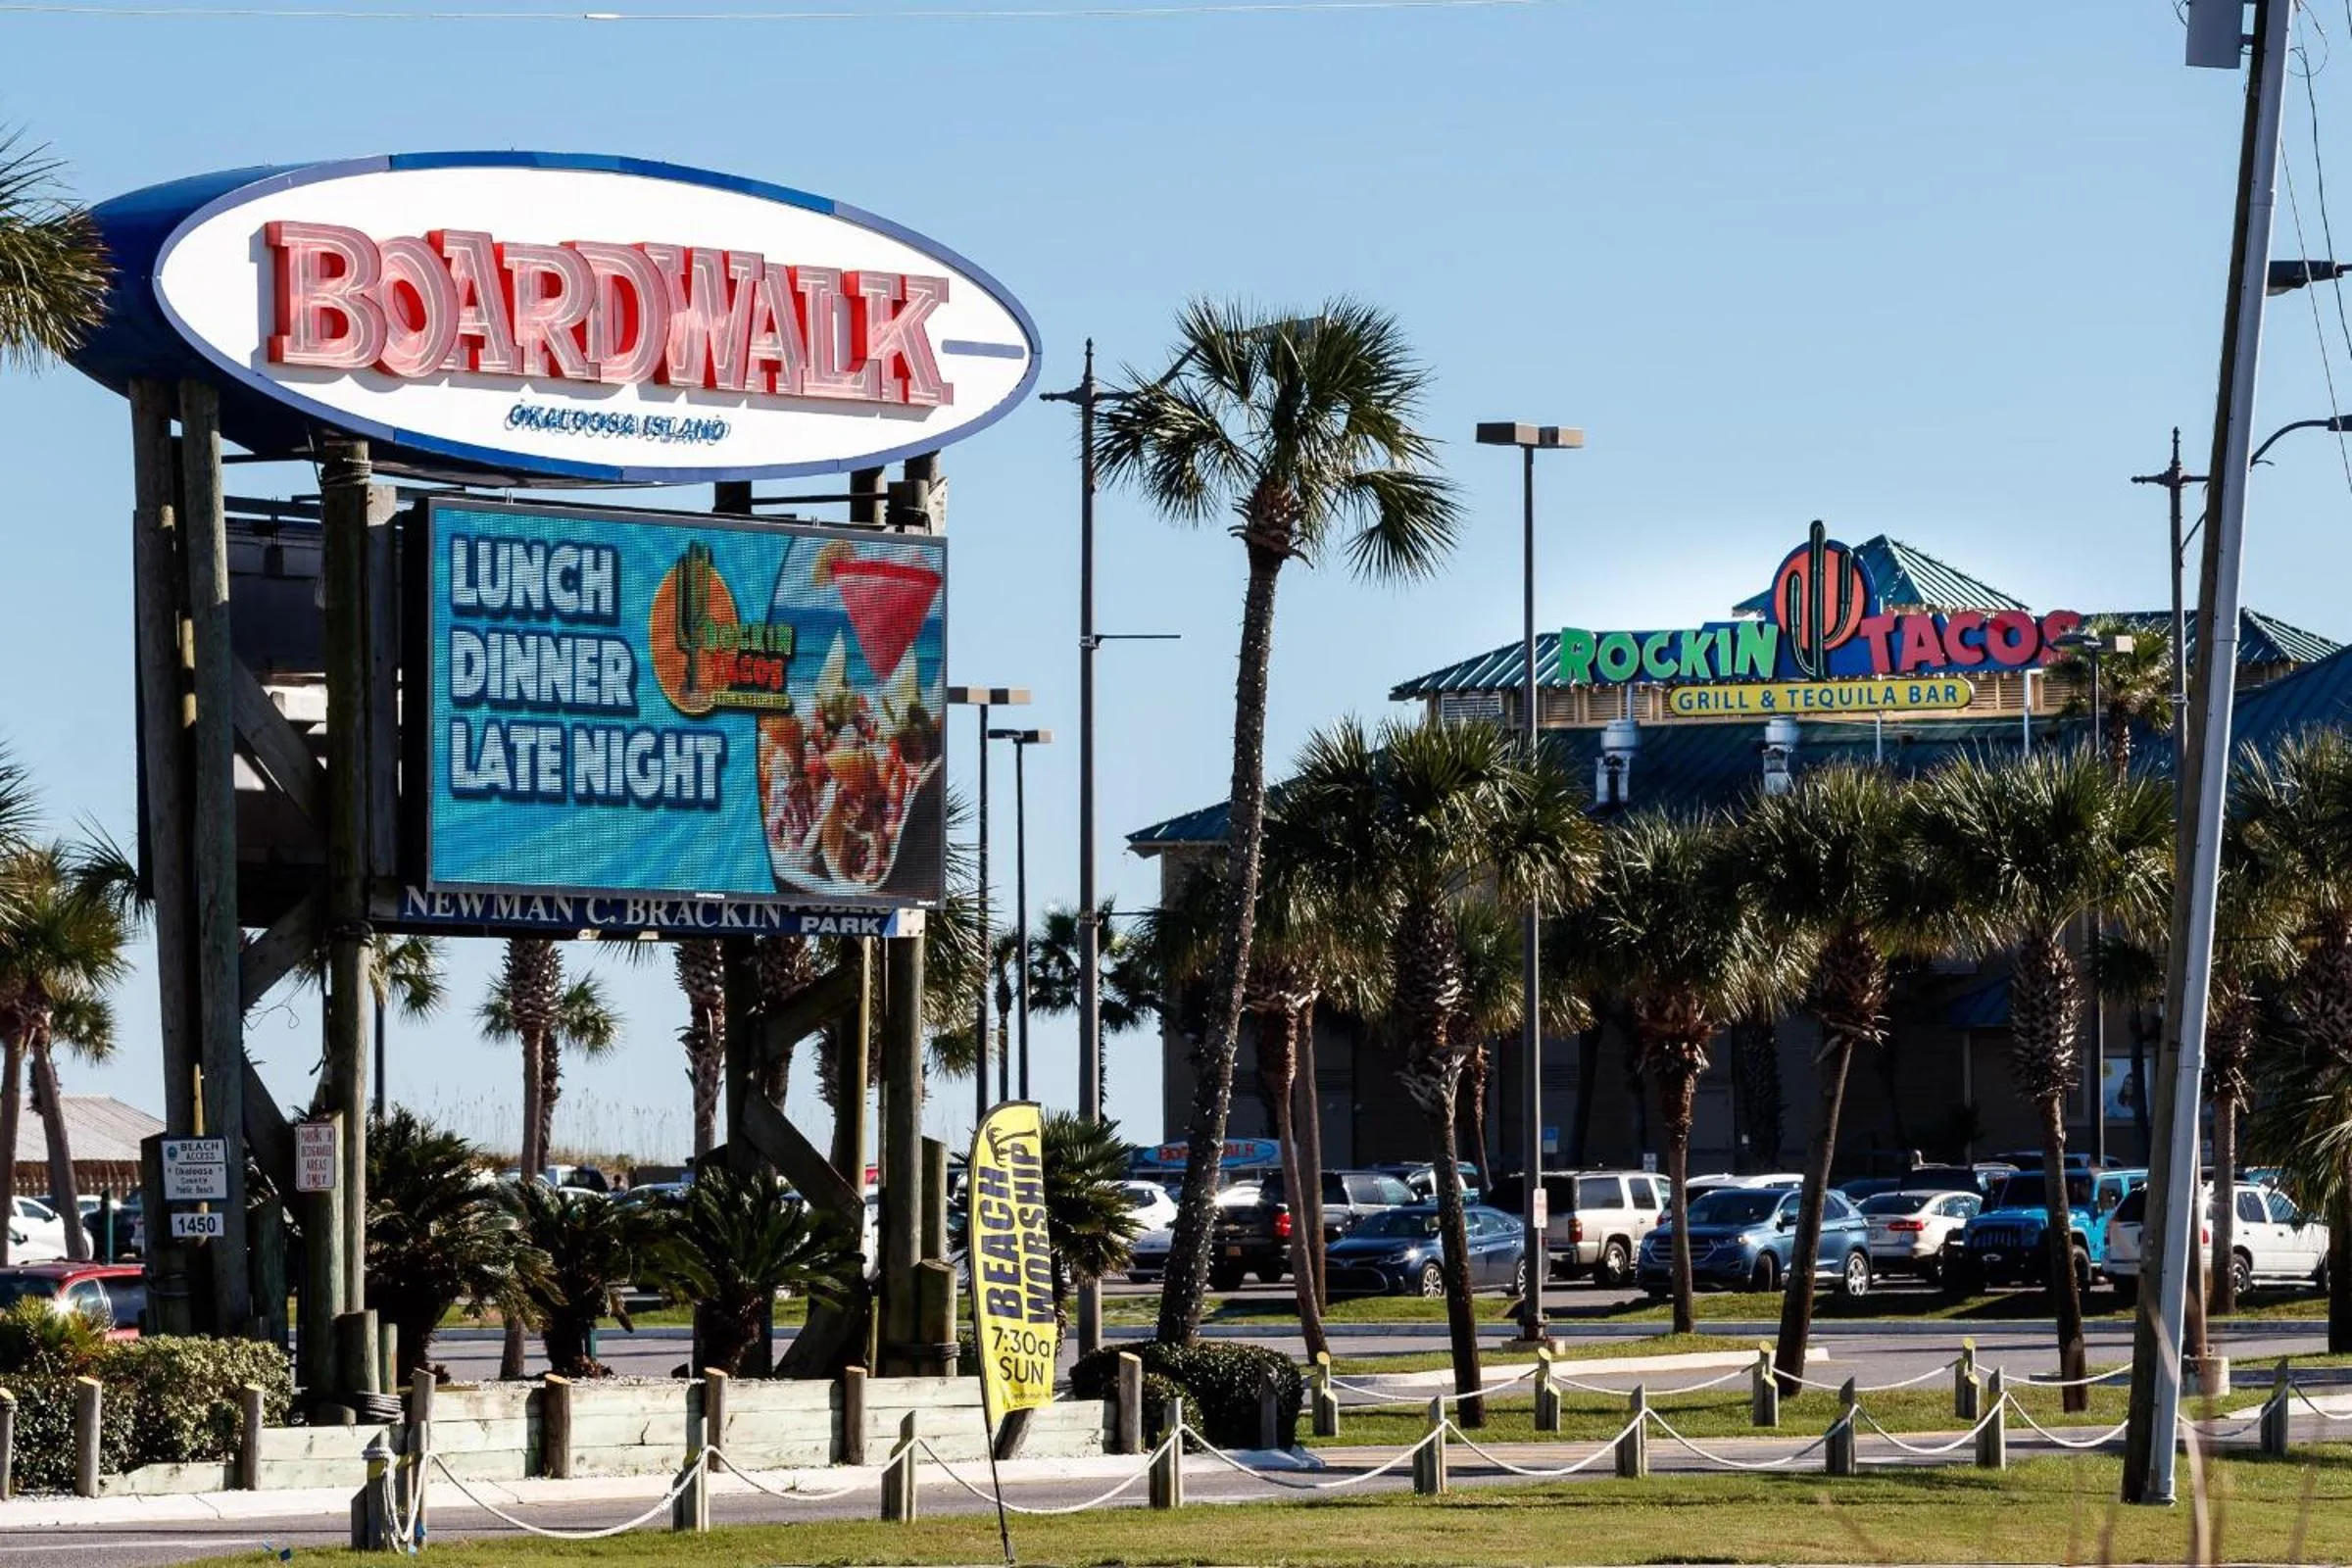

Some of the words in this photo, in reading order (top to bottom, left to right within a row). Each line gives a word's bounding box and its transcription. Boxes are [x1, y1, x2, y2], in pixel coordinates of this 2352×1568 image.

[267, 220, 955, 407] BOARDWALK
[507, 404, 636, 435] OKALOOSA
[643, 415, 728, 442] ISLAND
[450, 536, 616, 618] LUNCH
[1558, 620, 1779, 685] ROCKIN
[1859, 610, 2082, 674] TACOS
[450, 631, 635, 710] DINNER
[1678, 688, 1748, 710] GRILL
[1760, 687, 1776, 709] &
[1786, 686, 1897, 709] TEQUILA
[1908, 684, 1958, 705] BAR
[450, 720, 564, 795] LATE
[573, 728, 726, 804] NIGHT
[404, 885, 574, 922] NEWMAN
[587, 897, 616, 924] C.
[623, 898, 781, 929] BRACKIN
[800, 915, 881, 934] PARK
[180, 1142, 219, 1152] BEACH
[186, 1152, 216, 1161] ACCESS
[178, 1216, 216, 1234] 1450
[977, 1165, 1023, 1320] BEACH
[1010, 1143, 1054, 1324] WORSHIP
[991, 1325, 1051, 1359] 7:30a
[999, 1355, 1045, 1386] SUN
